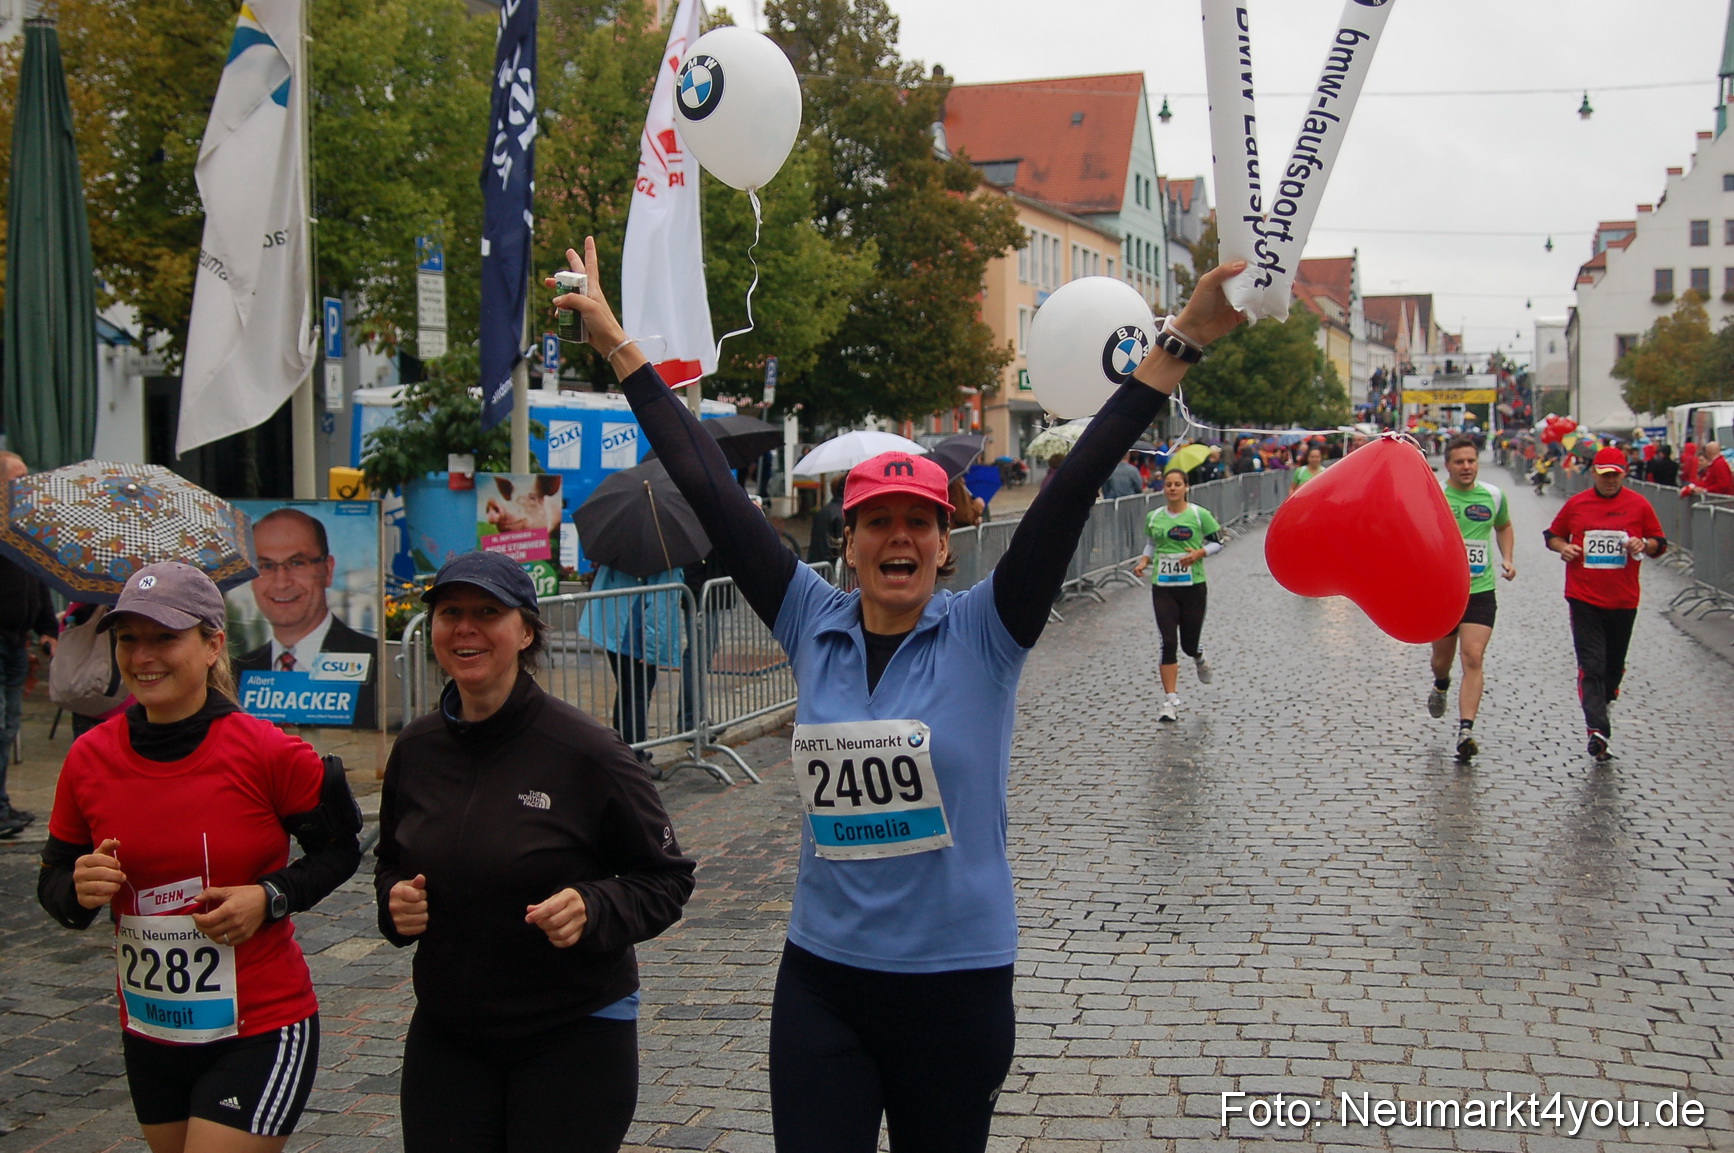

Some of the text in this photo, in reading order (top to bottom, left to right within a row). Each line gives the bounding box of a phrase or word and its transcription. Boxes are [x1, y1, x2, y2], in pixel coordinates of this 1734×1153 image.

[328, 306, 340, 351] P
[1588, 539, 1624, 554] 2564
[1469, 549, 1484, 563] 53
[321, 661, 348, 672] CSU
[247, 675, 276, 686] Albert
[243, 687, 351, 711] FÜRACKER
[794, 735, 902, 752] PARTL Neumarkt
[807, 755, 923, 808] 2409
[518, 793, 541, 803] NORTH
[529, 789, 541, 797] THE
[833, 818, 911, 842] Cornelia
[154, 888, 185, 905] DEHN
[120, 925, 140, 940] RTL
[121, 943, 222, 995] 2282
[145, 1002, 194, 1028] Margit
